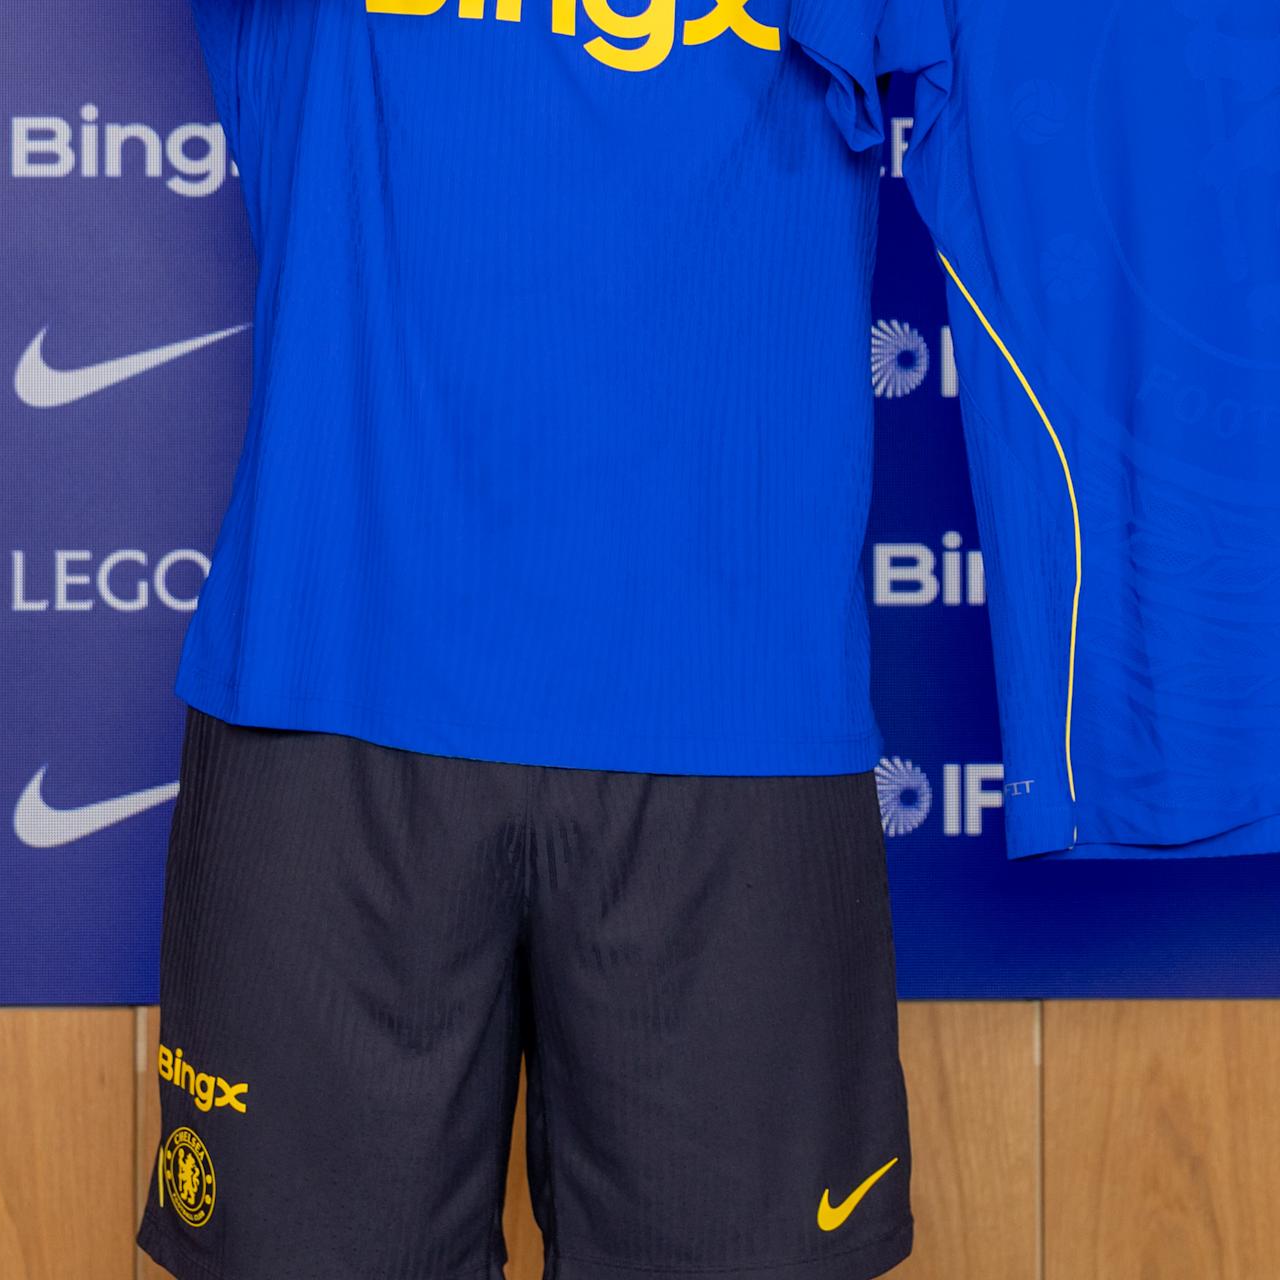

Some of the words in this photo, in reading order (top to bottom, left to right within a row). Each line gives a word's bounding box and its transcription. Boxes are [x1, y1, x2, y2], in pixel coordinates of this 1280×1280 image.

[11, 104, 238, 196] Bing
[13, 550, 210, 611] LEGO
[174, 1131, 204, 1162] CHELSEA
